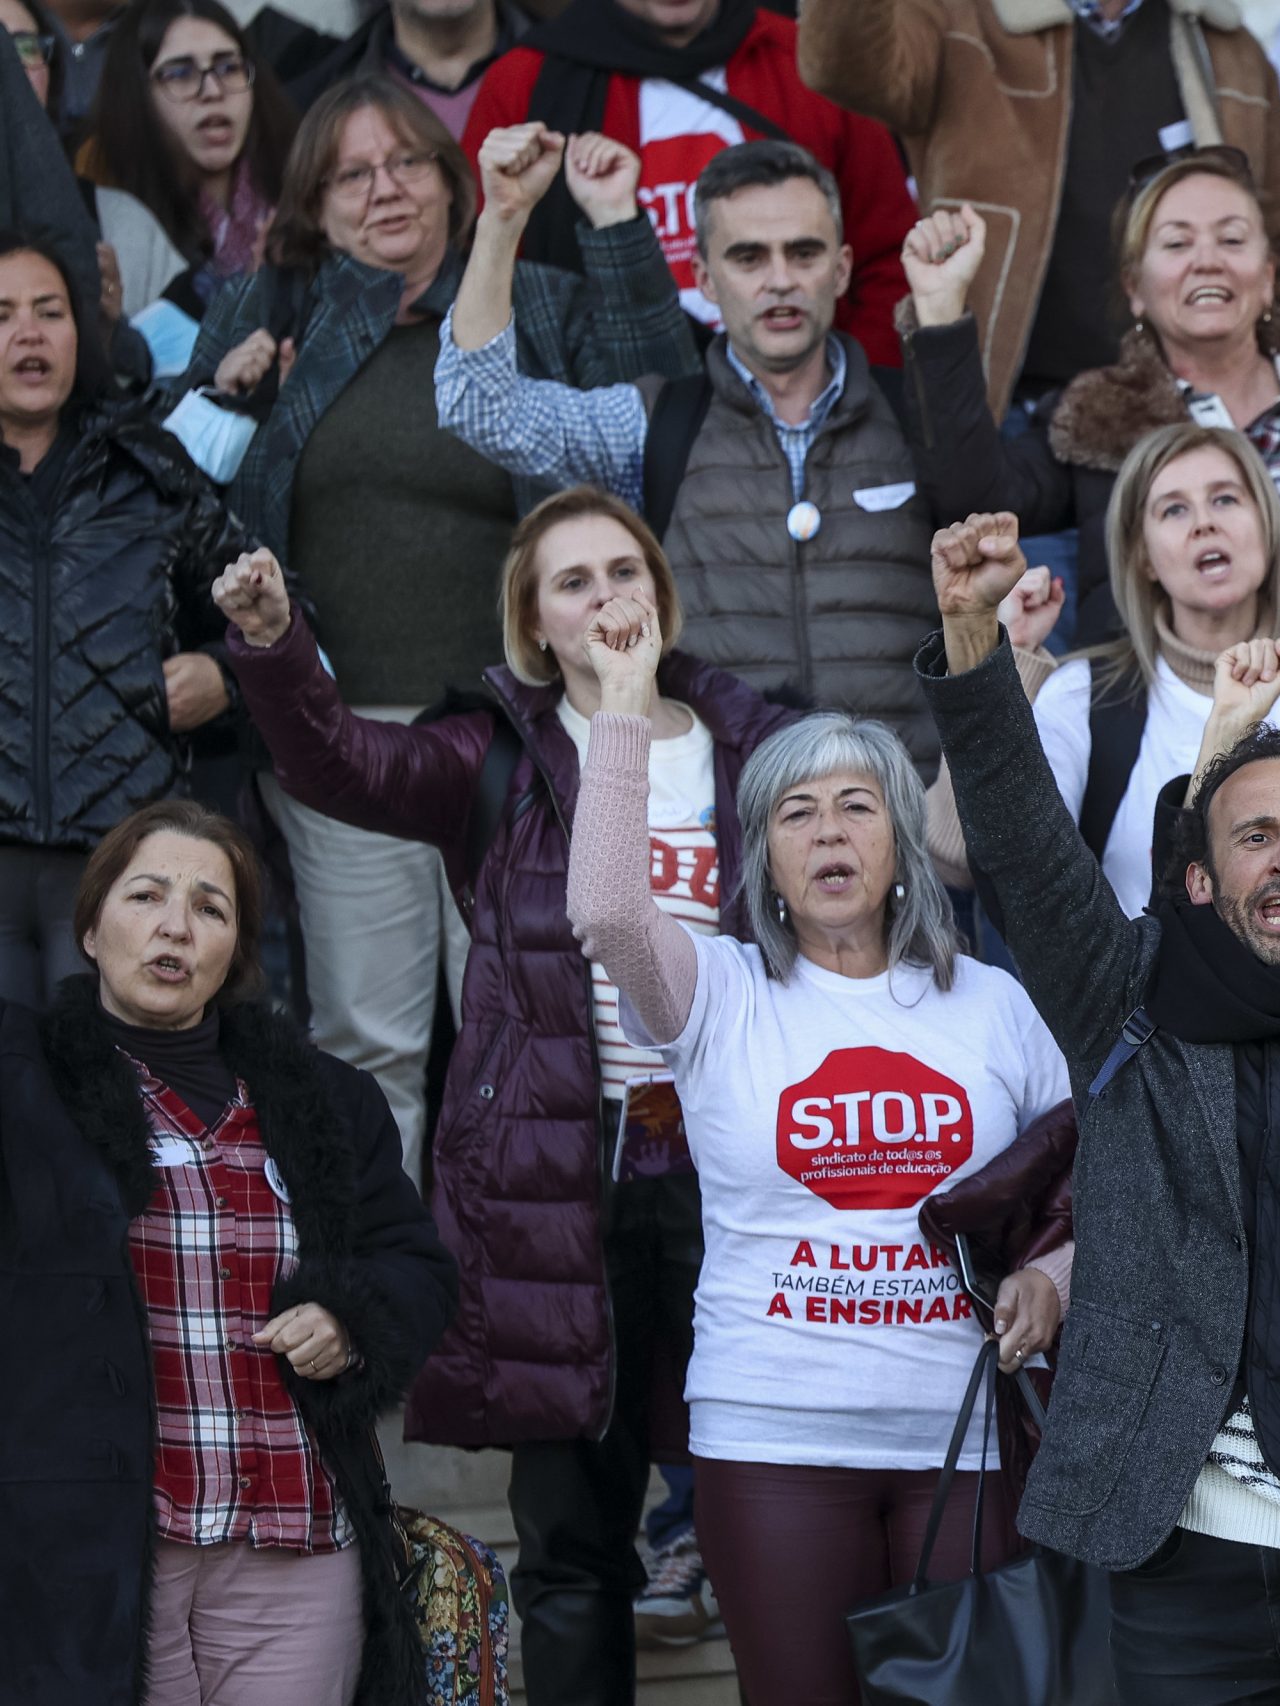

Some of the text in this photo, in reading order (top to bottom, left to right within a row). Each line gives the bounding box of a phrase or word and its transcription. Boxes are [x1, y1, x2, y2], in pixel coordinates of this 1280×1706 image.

[811, 1148, 942, 1166] sindicato de tod@s @s
[800, 1162, 951, 1183] profissionais de educação
[790, 1240, 817, 1268] A
[772, 1272, 960, 1296] TAMBÉM ESTAMO
[766, 1292, 973, 1325] A ENSINAR
